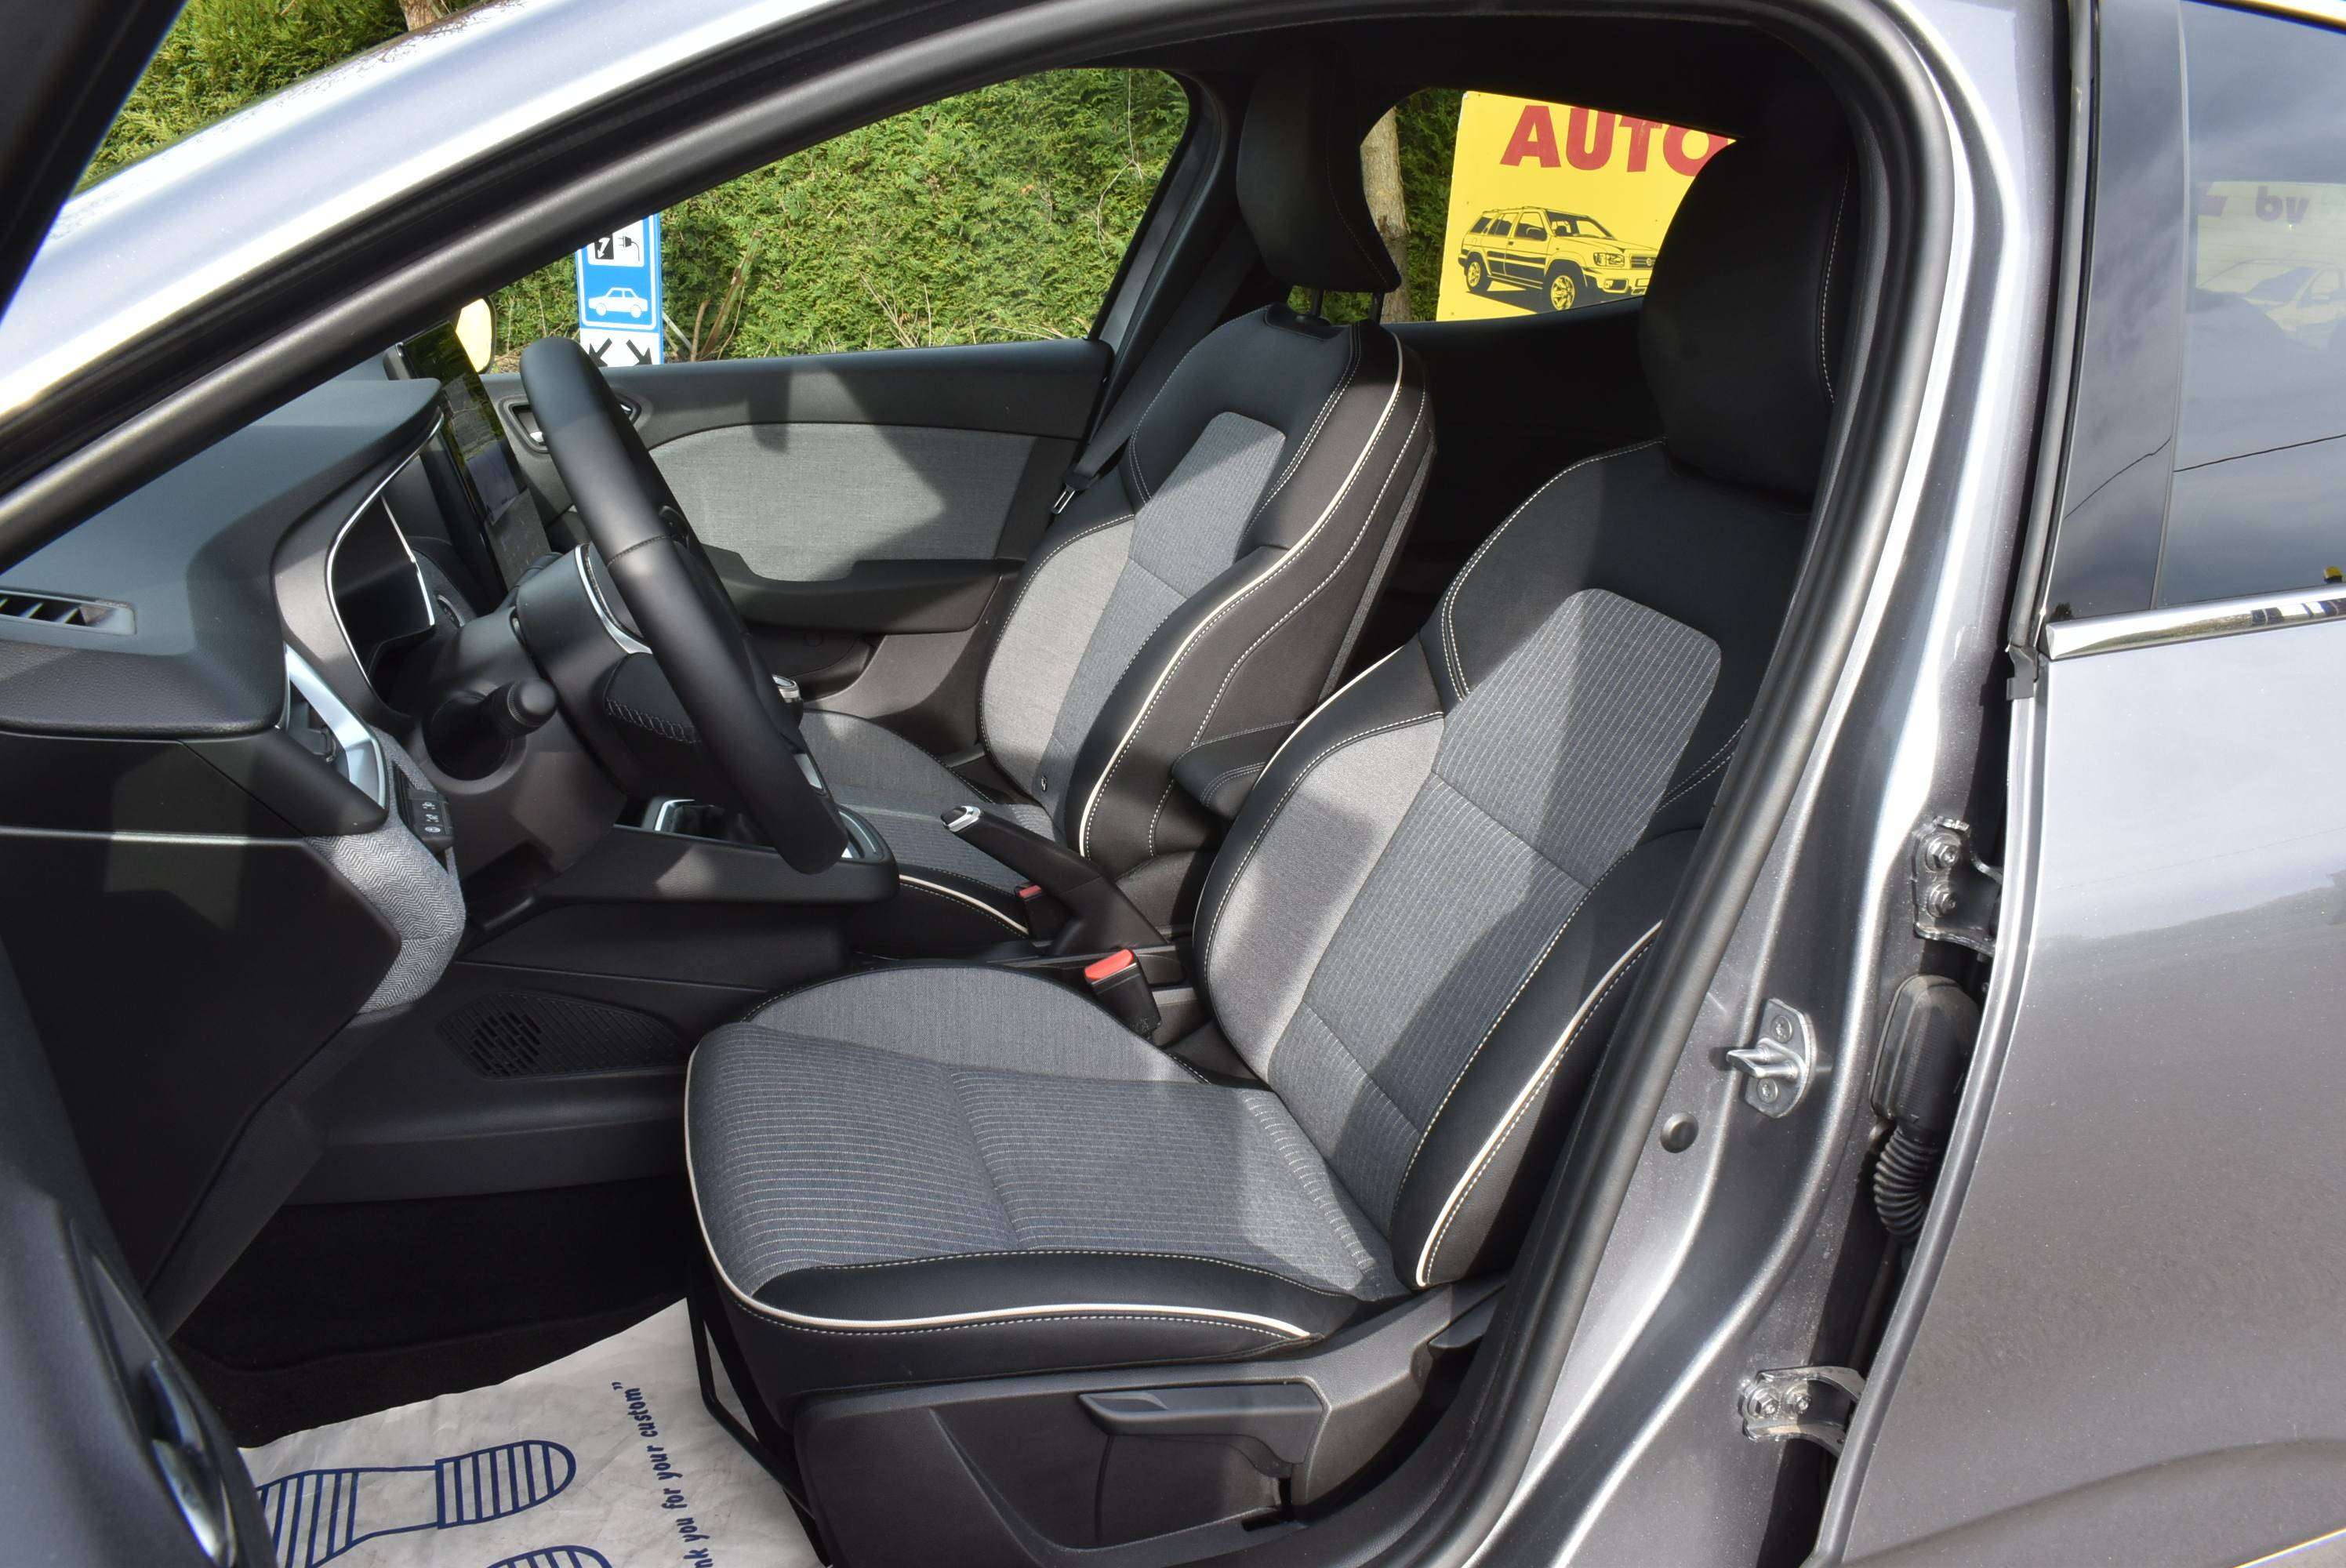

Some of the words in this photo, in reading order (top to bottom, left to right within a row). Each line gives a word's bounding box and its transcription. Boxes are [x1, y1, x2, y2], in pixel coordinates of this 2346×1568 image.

[1500, 104, 1730, 177] AUTO
[2255, 184, 2311, 225] bv
[646, 1445, 684, 1481] your
[661, 1487, 688, 1510] for
[675, 1517, 710, 1543] you
[683, 1548, 714, 1568] nk
